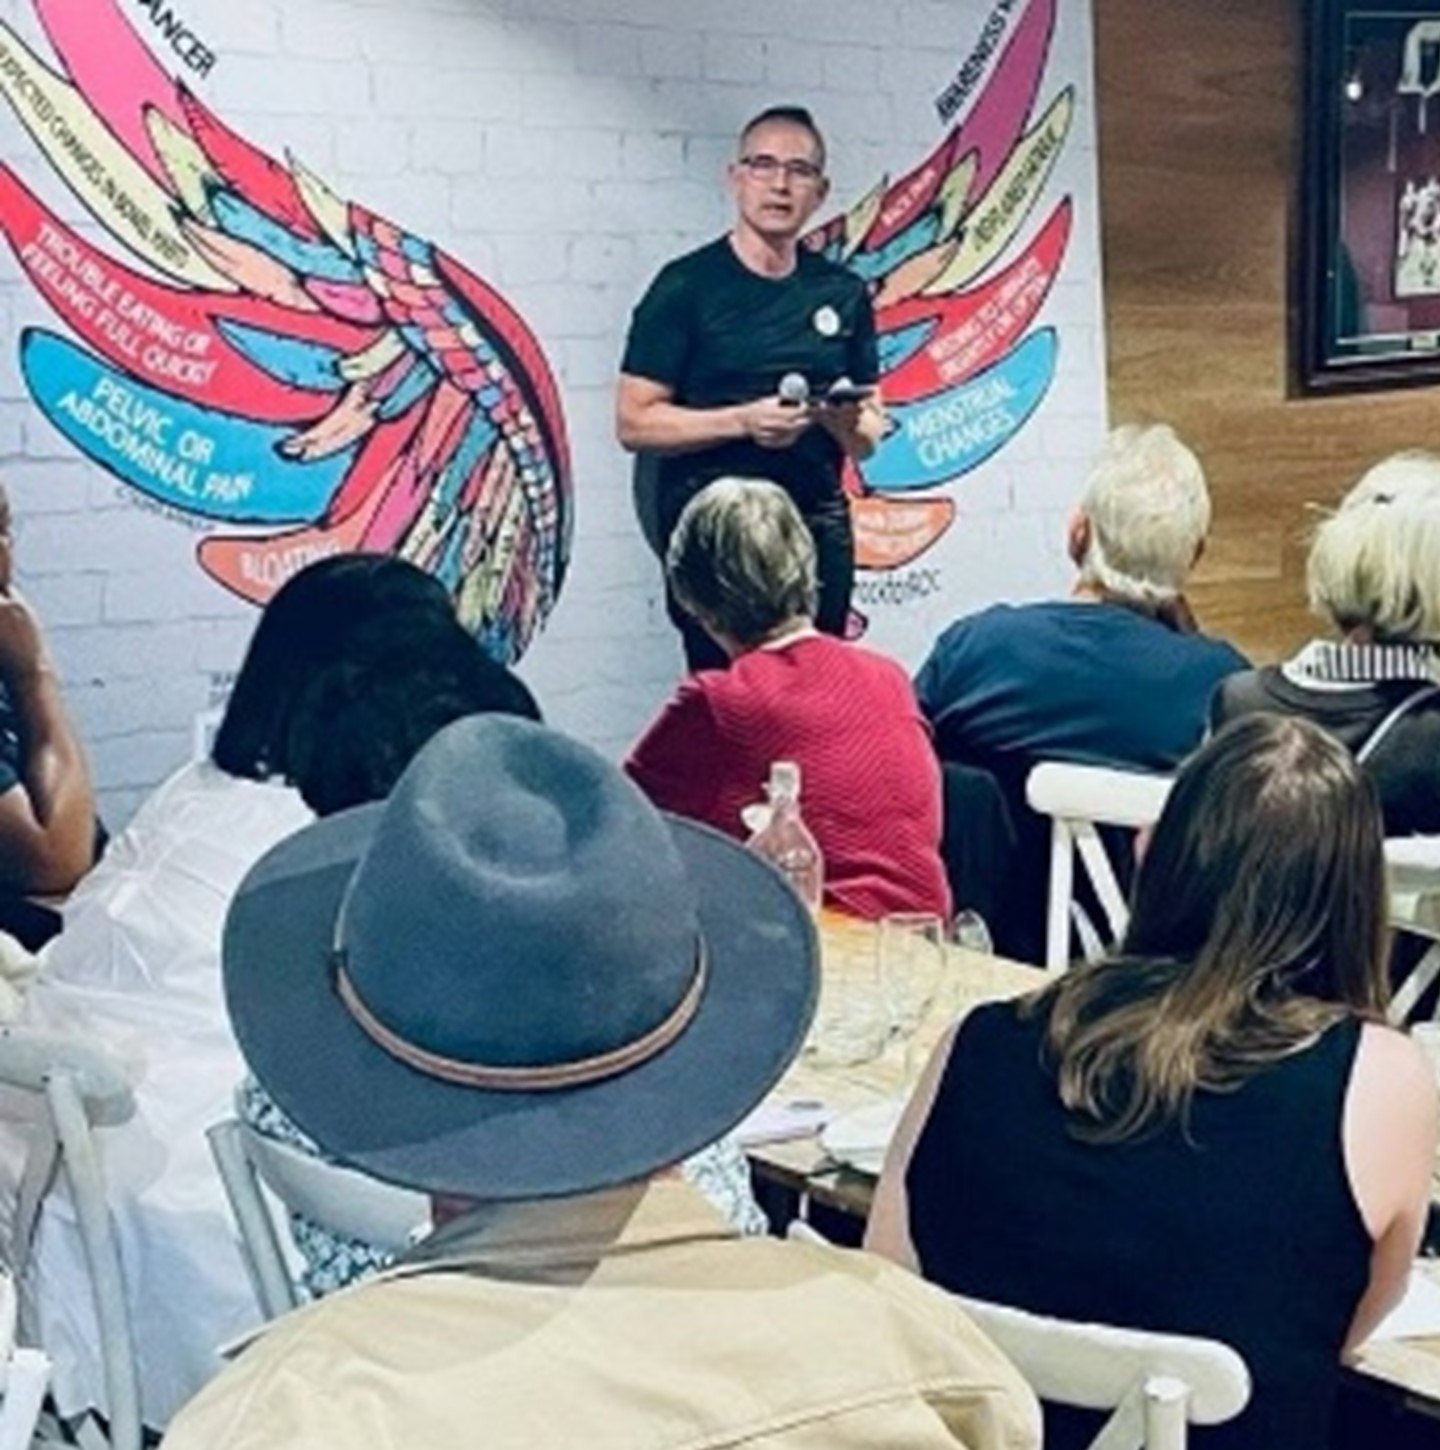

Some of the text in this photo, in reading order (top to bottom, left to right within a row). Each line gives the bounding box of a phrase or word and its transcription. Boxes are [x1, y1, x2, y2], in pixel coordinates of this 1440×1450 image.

[21, 243, 97, 319] FEELING
[37, 222, 121, 297] TROUBLE
[57, 390, 199, 496] ABDOMINAL
[91, 377, 215, 465] PELVIC OR
[917, 410, 1014, 468] CHANGES
